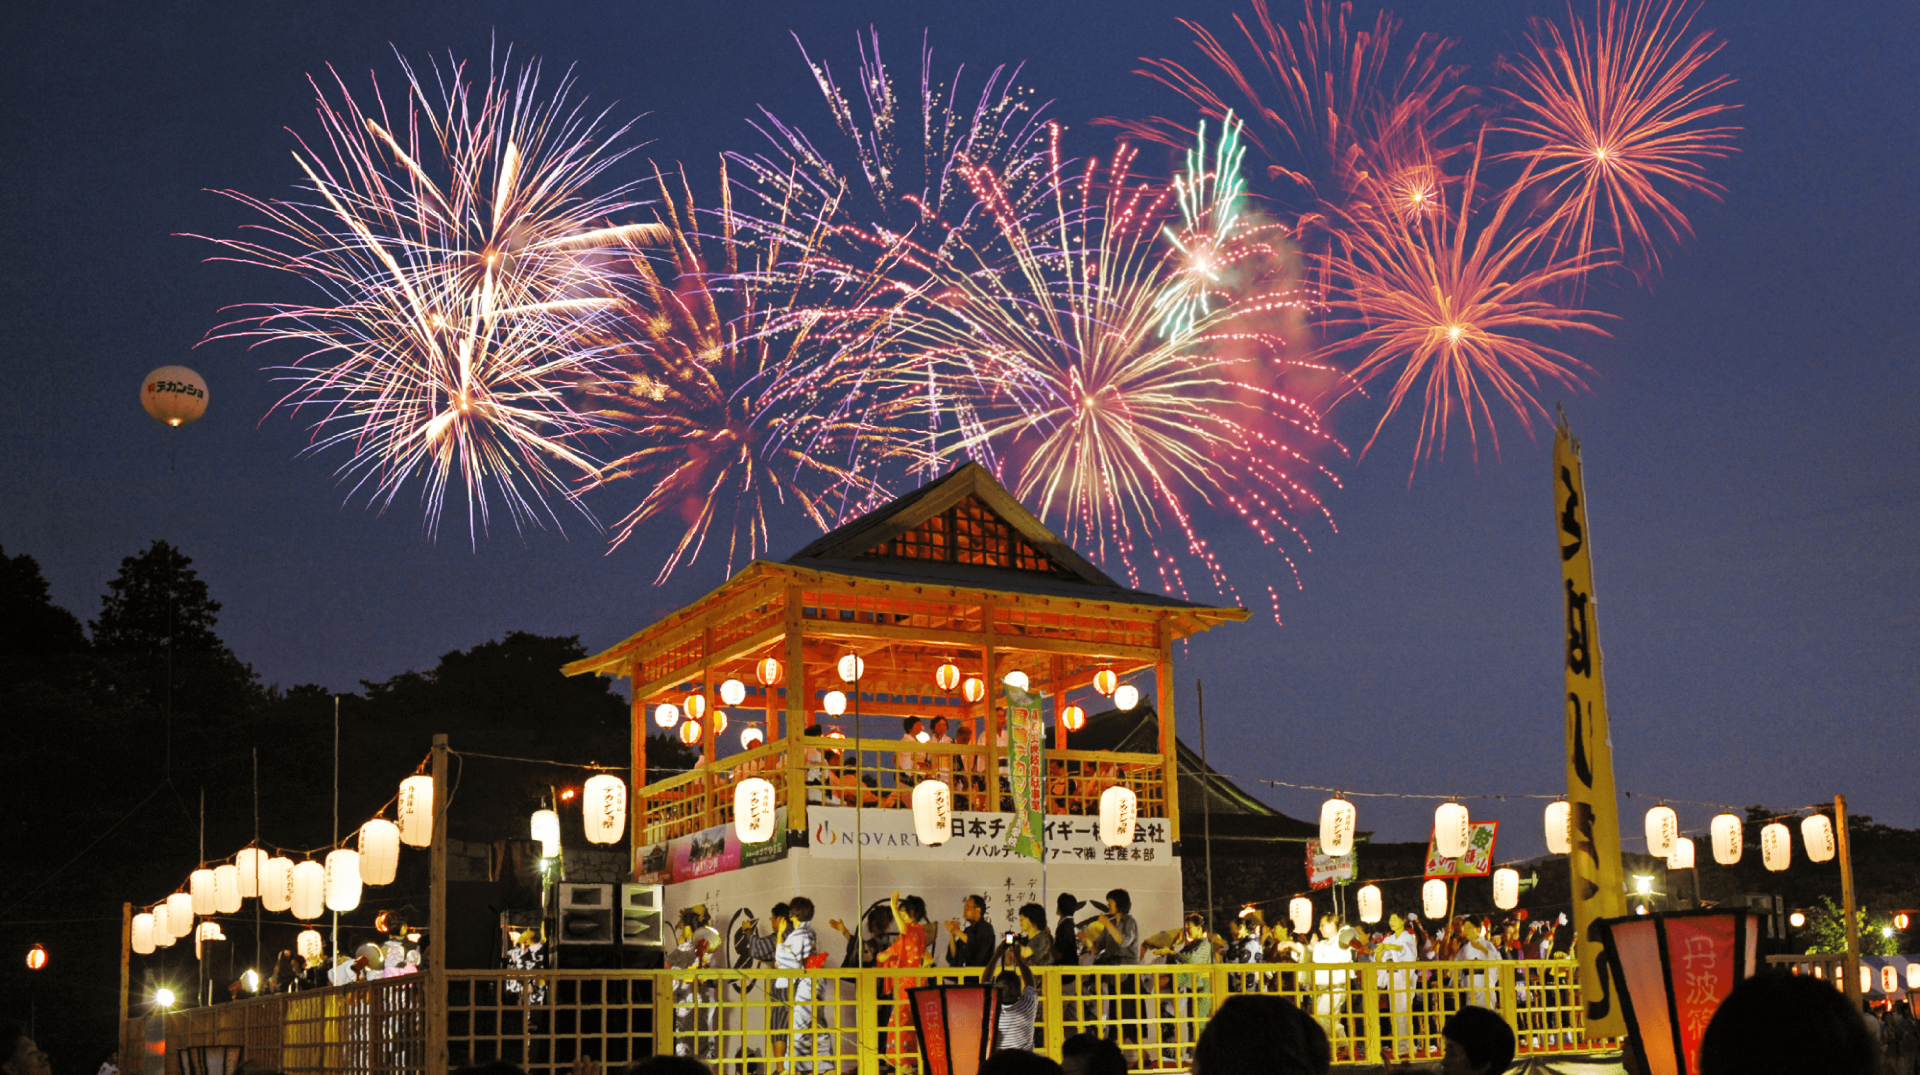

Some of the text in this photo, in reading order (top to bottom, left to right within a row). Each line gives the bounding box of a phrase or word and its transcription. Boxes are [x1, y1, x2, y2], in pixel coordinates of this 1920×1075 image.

[842, 832, 920, 847] NOVART
[952, 817, 1165, 844] 日本チイギー会社
[1682, 936, 1720, 1074] 丹波篠
